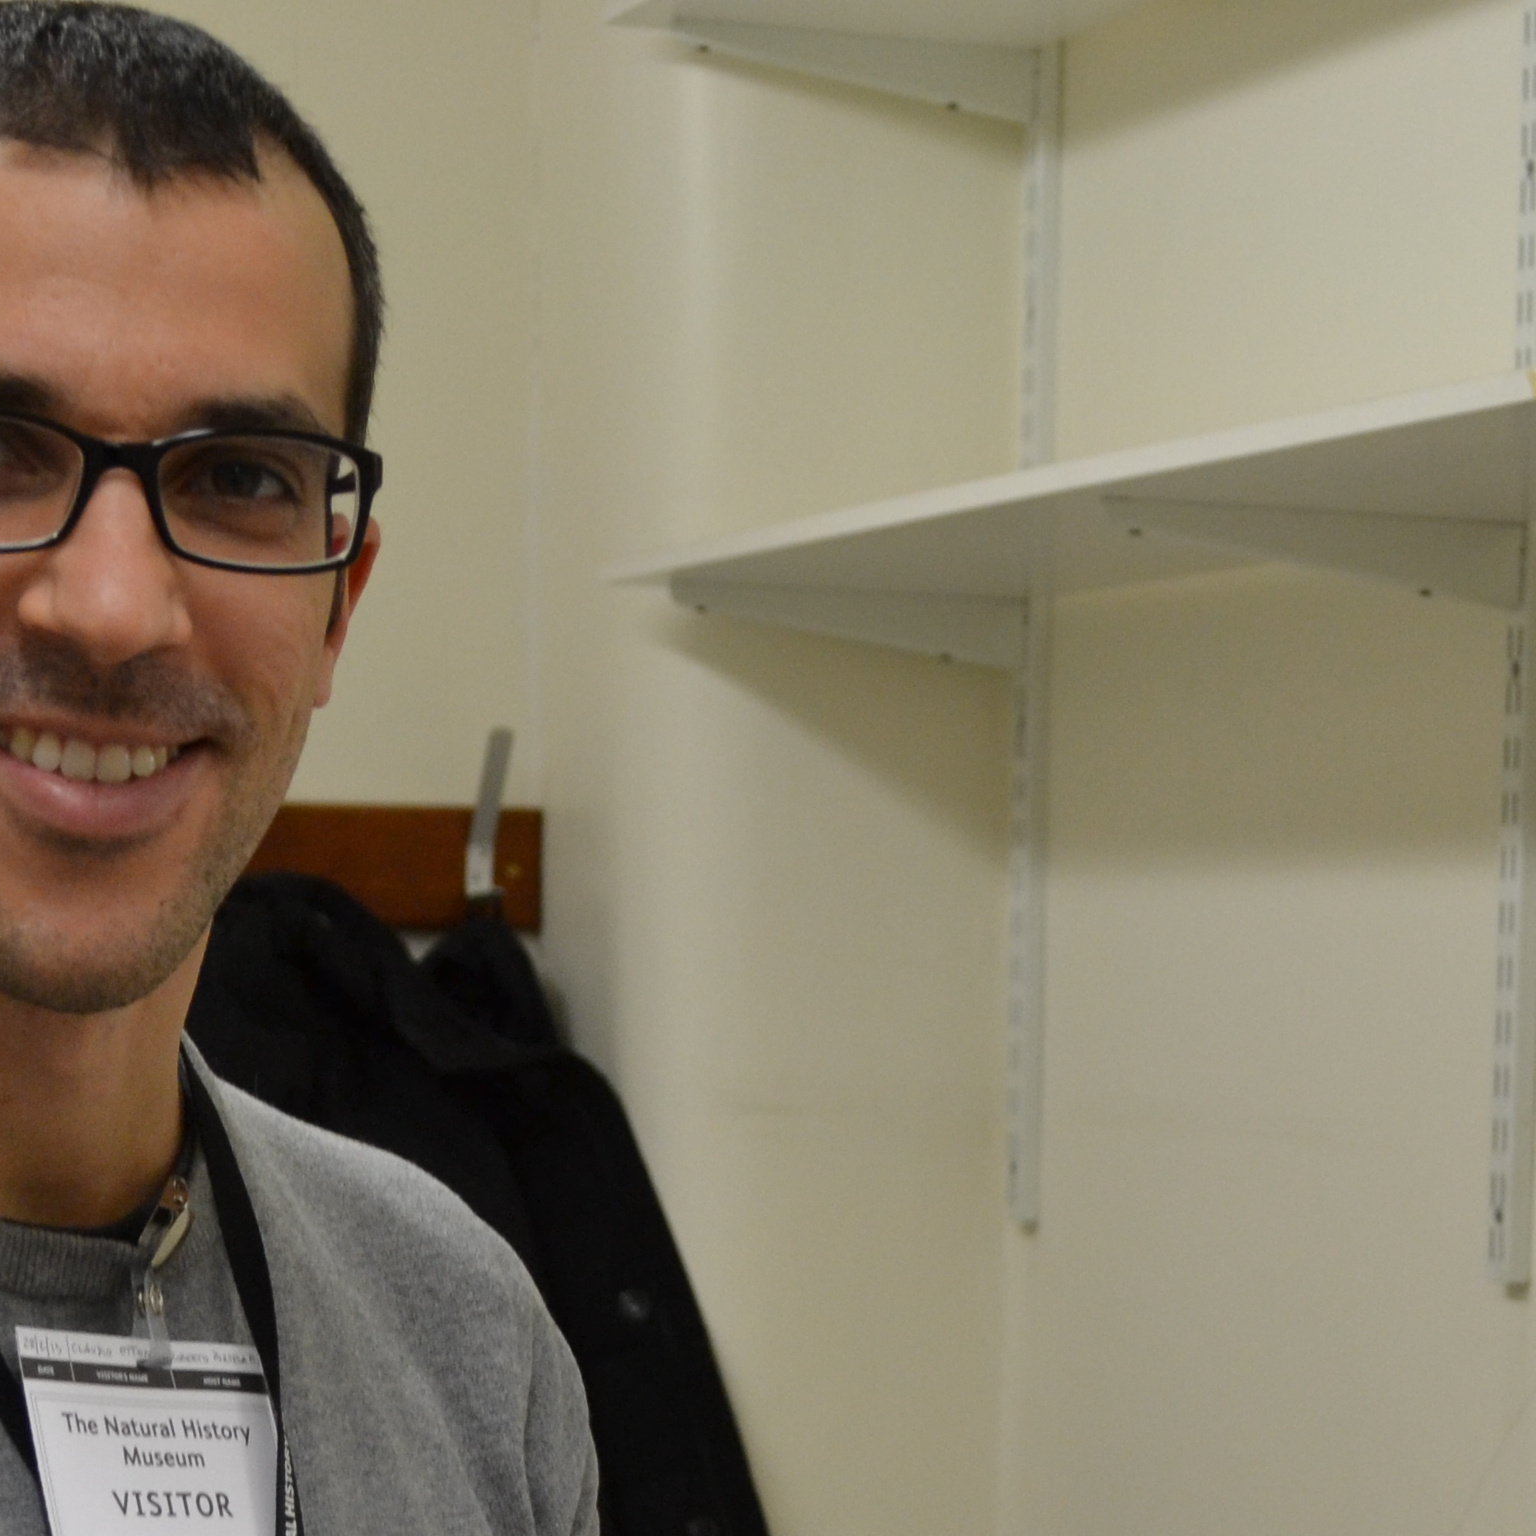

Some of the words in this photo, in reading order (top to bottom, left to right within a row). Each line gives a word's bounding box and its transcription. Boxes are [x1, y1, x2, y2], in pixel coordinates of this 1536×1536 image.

[61, 1412, 99, 1435] The
[104, 1415, 176, 1438] Natural
[181, 1418, 251, 1446] History
[122, 1446, 206, 1468] Museum
[111, 1489, 234, 1518] VISITOR
